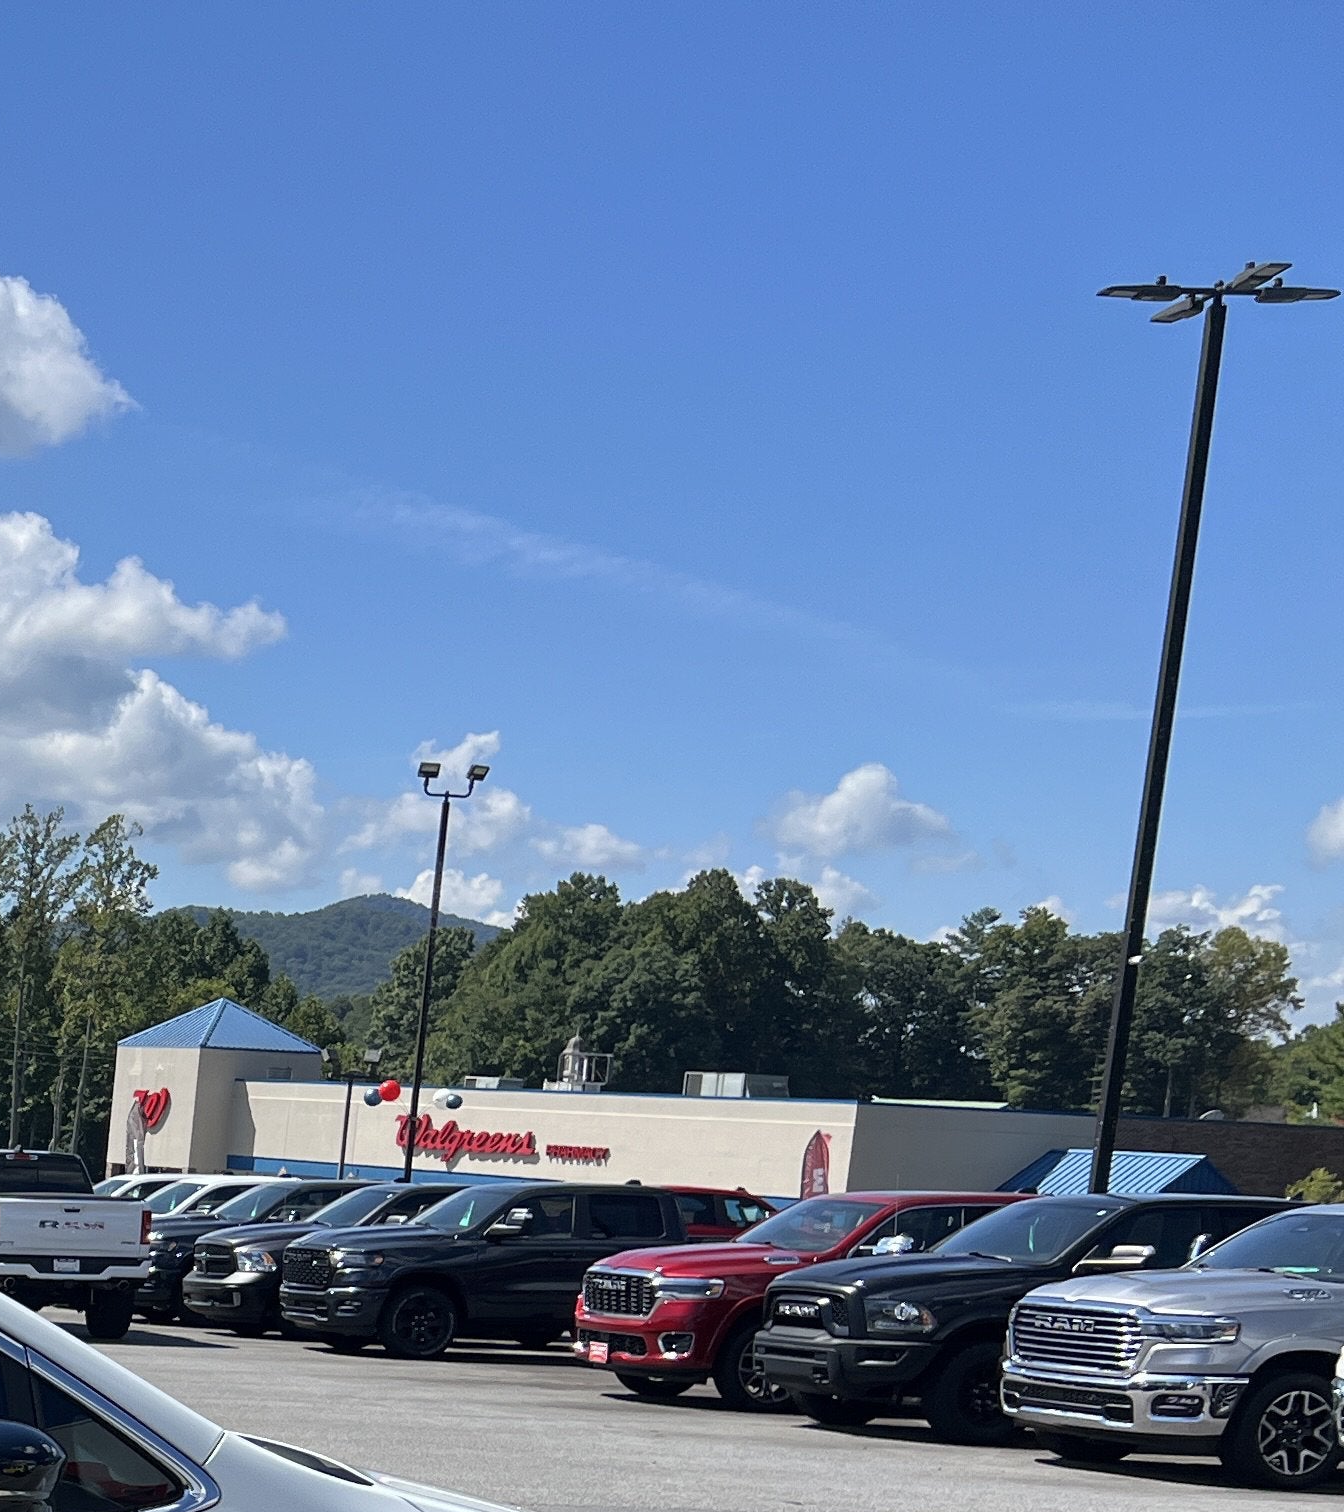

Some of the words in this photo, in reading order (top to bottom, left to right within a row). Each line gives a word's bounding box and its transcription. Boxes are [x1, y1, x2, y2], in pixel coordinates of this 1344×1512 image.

[395, 1113, 536, 1162] Walgreens
[545, 1144, 610, 1160] PHARMACY
[39, 1219, 105, 1231] RAM
[778, 1303, 820, 1318] RAM
[1034, 1315, 1095, 1332] RAM
